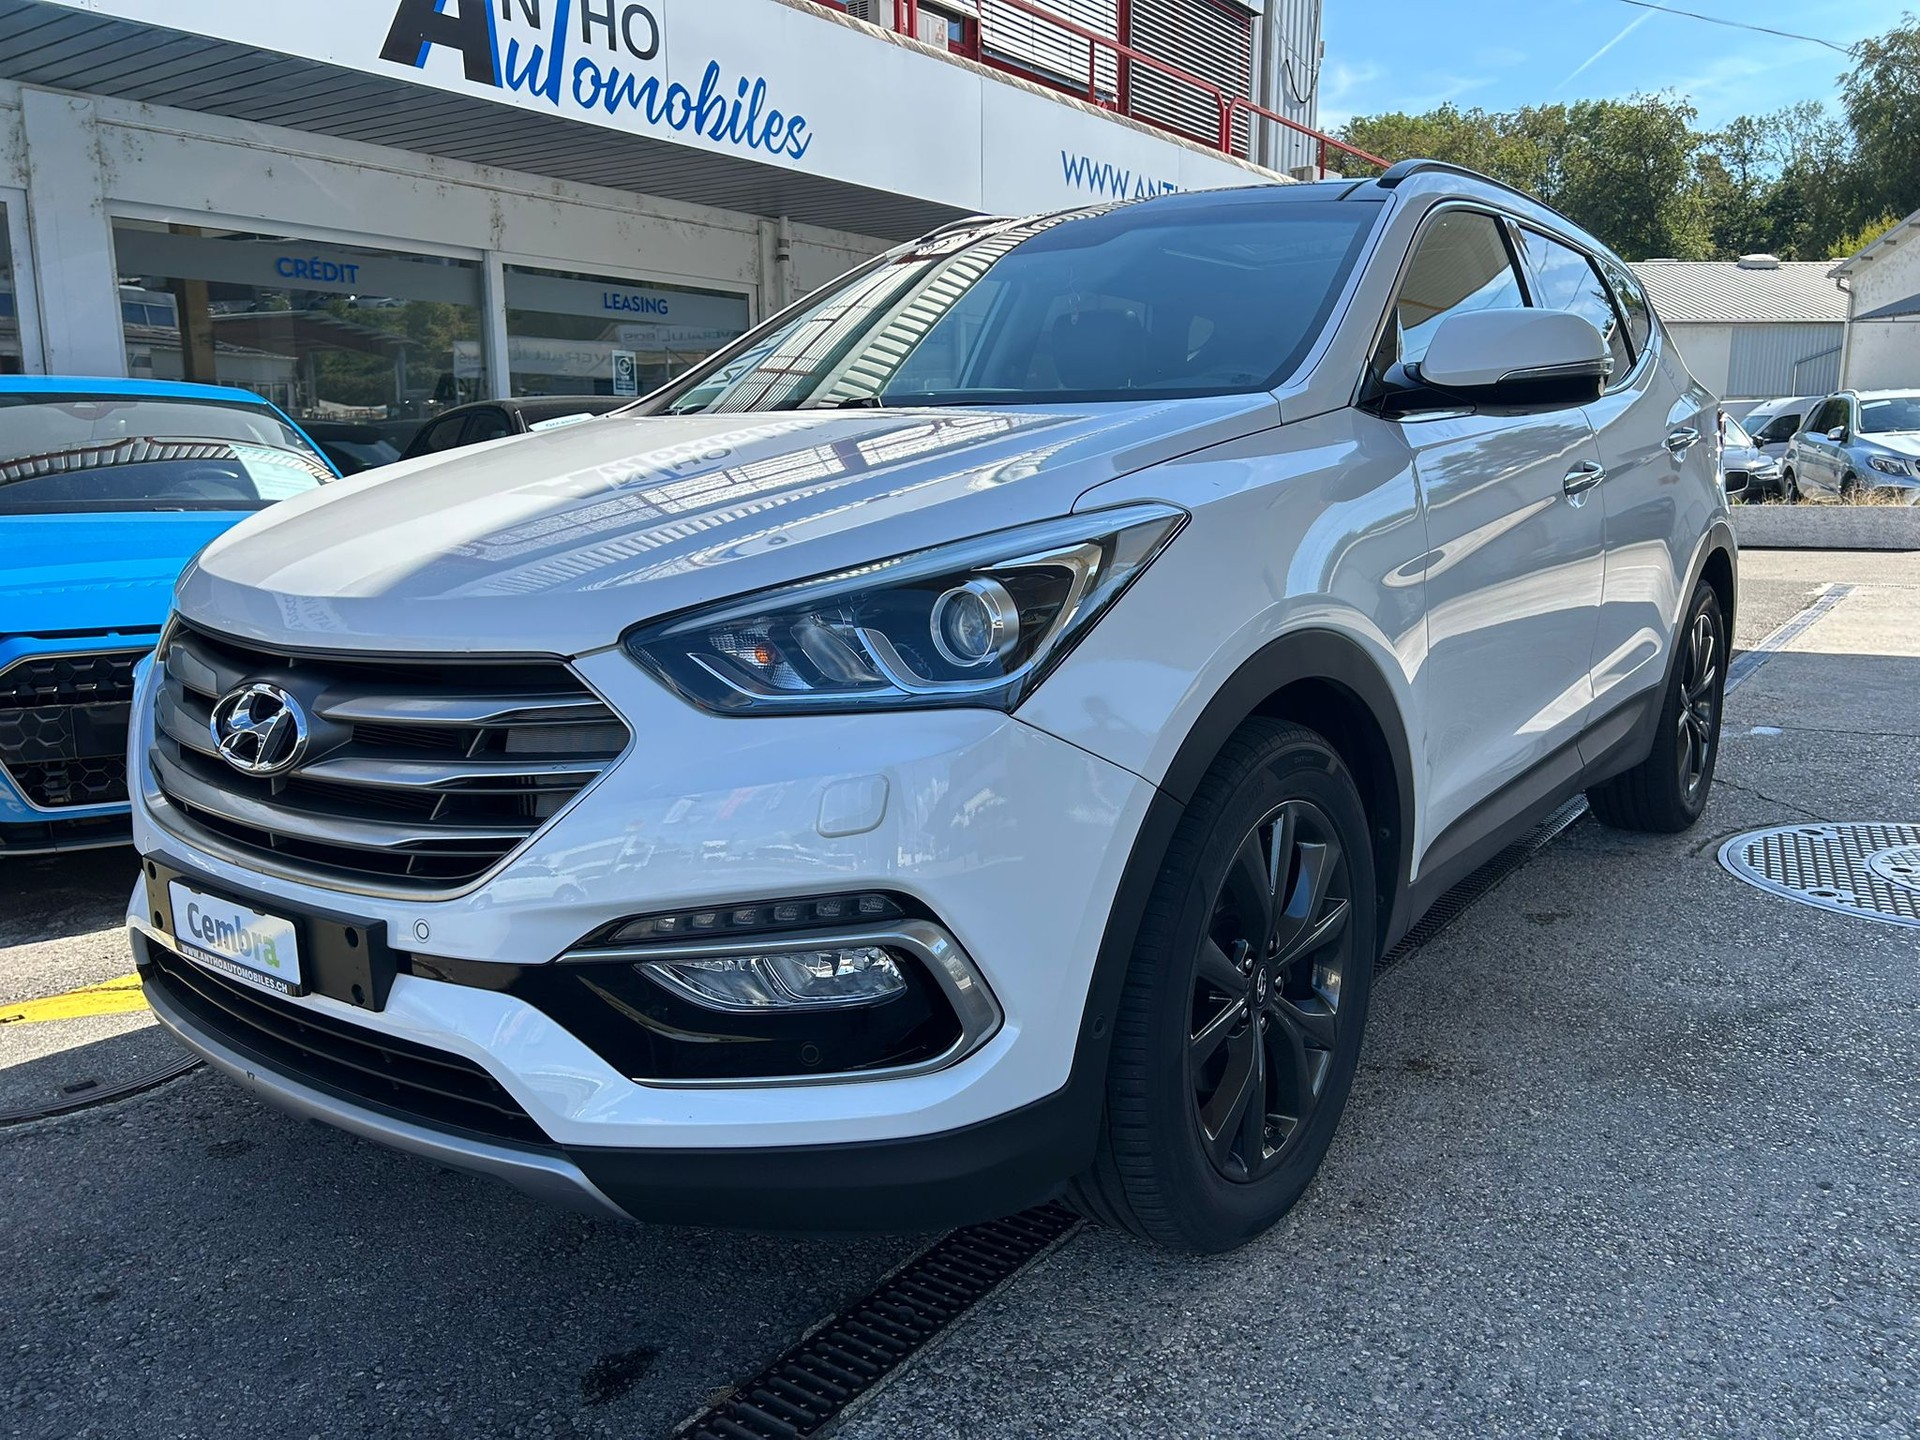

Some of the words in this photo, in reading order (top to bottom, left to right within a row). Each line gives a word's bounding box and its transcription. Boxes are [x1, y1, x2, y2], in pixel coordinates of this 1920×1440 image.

[276, 256, 360, 285] CRÉDIT
[603, 292, 669, 315] LEASING
[187, 902, 280, 968] Cembra
[182, 944, 288, 994] WWW.ANTHOAUTOMOBILES.CH
